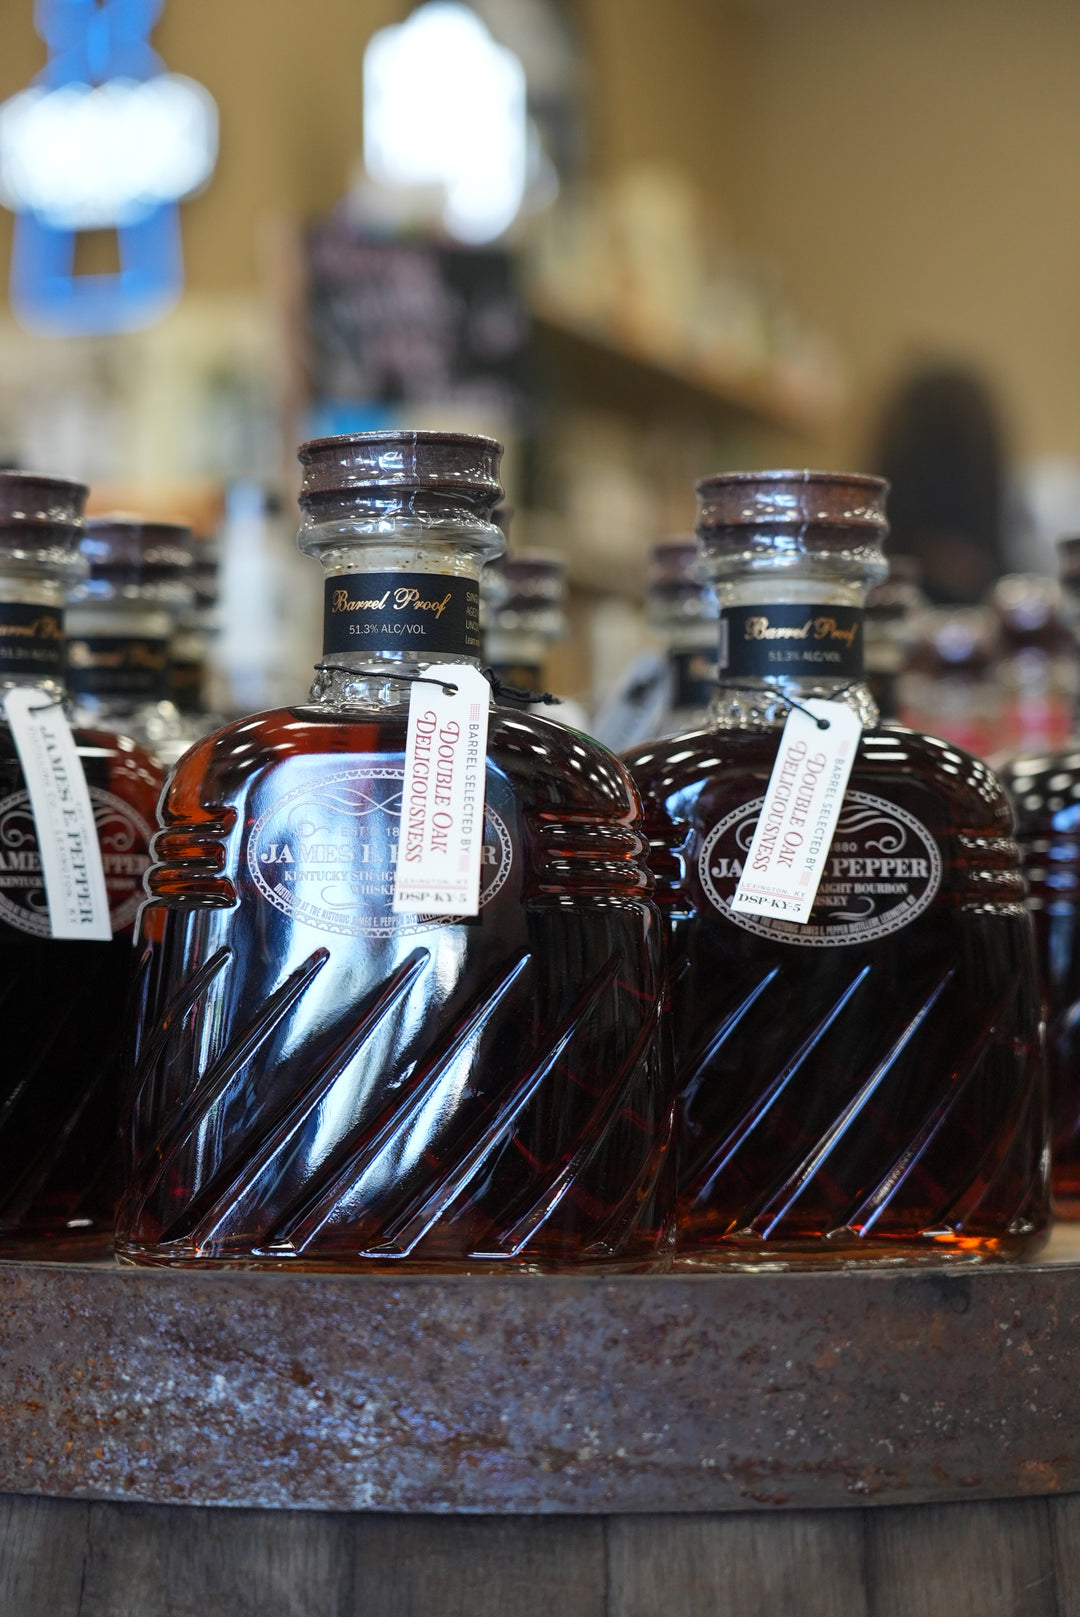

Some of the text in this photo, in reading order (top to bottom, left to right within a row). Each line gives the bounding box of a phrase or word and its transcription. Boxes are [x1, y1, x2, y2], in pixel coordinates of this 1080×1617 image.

[332, 587, 452, 620] Barrel Proof
[349, 623, 427, 634] 51.3% ALC/VOL
[744, 616, 860, 648] Barrel Proof
[405, 710, 437, 863] DELICIOUSNESS
[430, 721, 460, 854] DOUBLE OAK
[460, 724, 480, 856] BARREL SELECTED BY
[752, 741, 807, 872] DELICIOUSNESS
[777, 753, 826, 867] DOUBLE OAK
[804, 758, 844, 871] BARREL SELECTED BY
[40, 725, 70, 801] JAMES
[67, 832, 93, 923] PEPPER
[386, 826, 400, 837] 18
[261, 843, 354, 864] JAMES
[361, 844, 384, 863] E.
[831, 858, 929, 878] PEPPER
[284, 870, 397, 881] KENTUCKY STRAIG
[854, 882, 908, 894] BOURBON
[738, 893, 802, 912] DSP-KY-5
